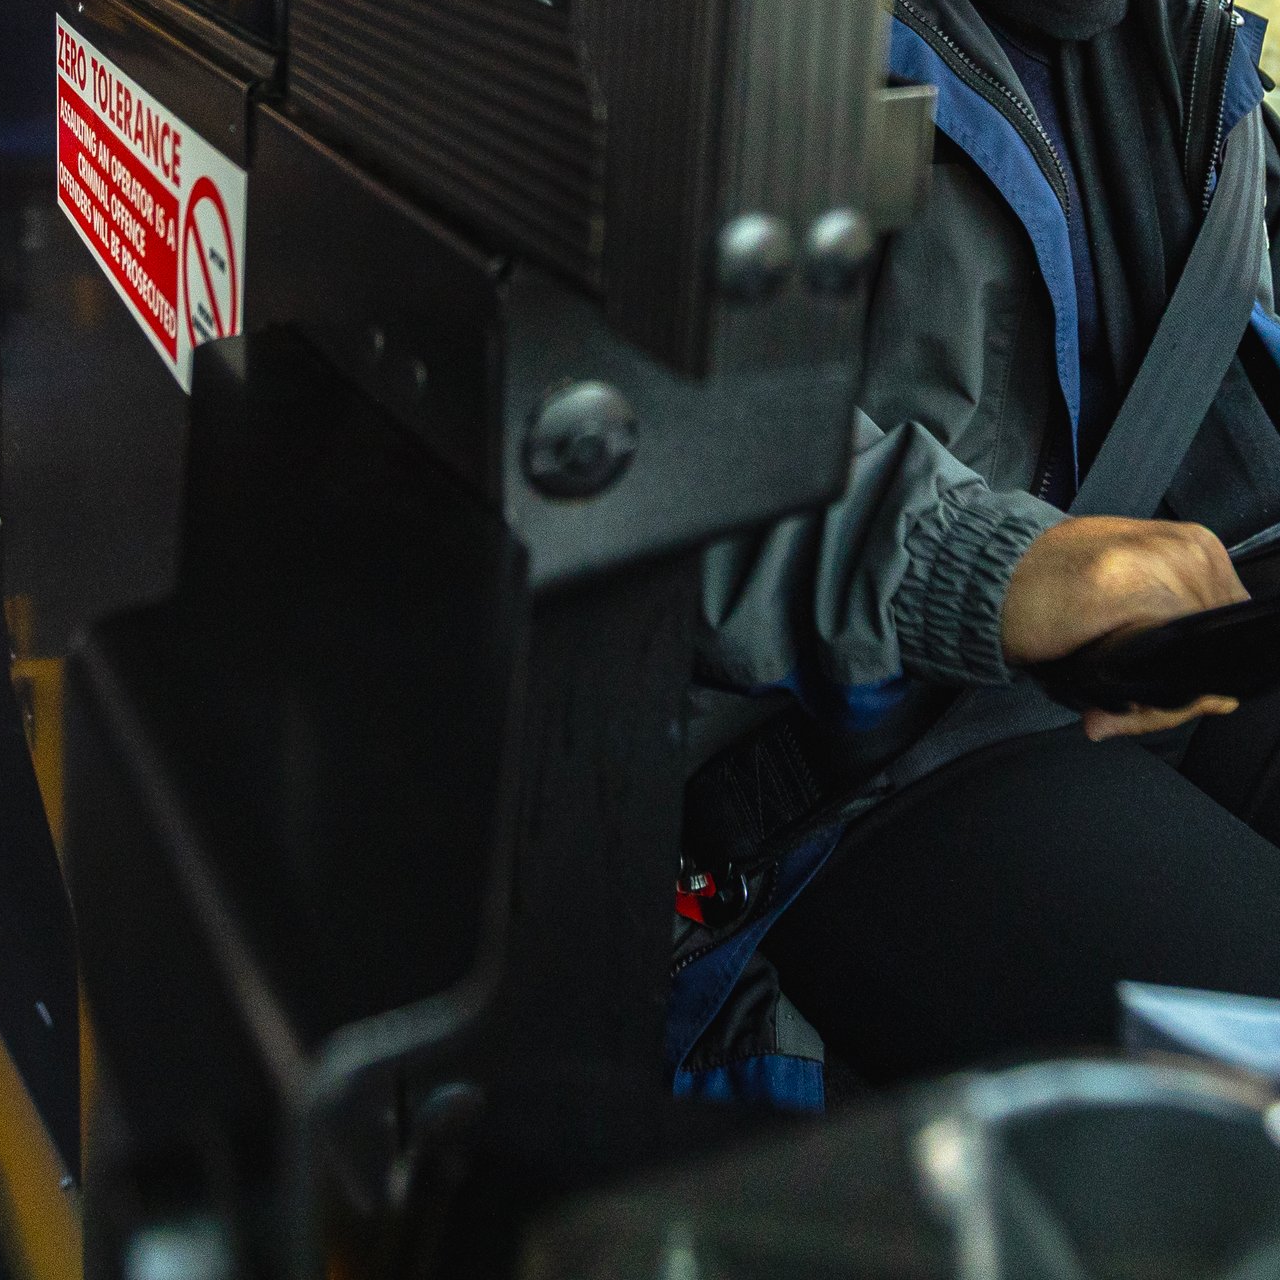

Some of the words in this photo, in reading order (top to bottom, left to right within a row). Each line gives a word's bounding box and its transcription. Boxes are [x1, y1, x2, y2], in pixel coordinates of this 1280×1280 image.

[58, 24, 87, 91] ZERO
[91, 56, 182, 188] TOLERANCE
[60, 96, 97, 157] ASSAULTING
[98, 140, 110, 173] AN
[111, 155, 154, 226] OPERATOR
[155, 203, 166, 239] IS
[166, 217, 176, 252] A
[59, 161, 92, 223] OFFENDERS
[92, 205, 110, 249] WILL
[110, 230, 121, 264] BE
[121, 245, 176, 339] PROSECUTED
[77, 151, 110, 212] CRIMINAL
[110, 193, 146, 258] OFFENCE
